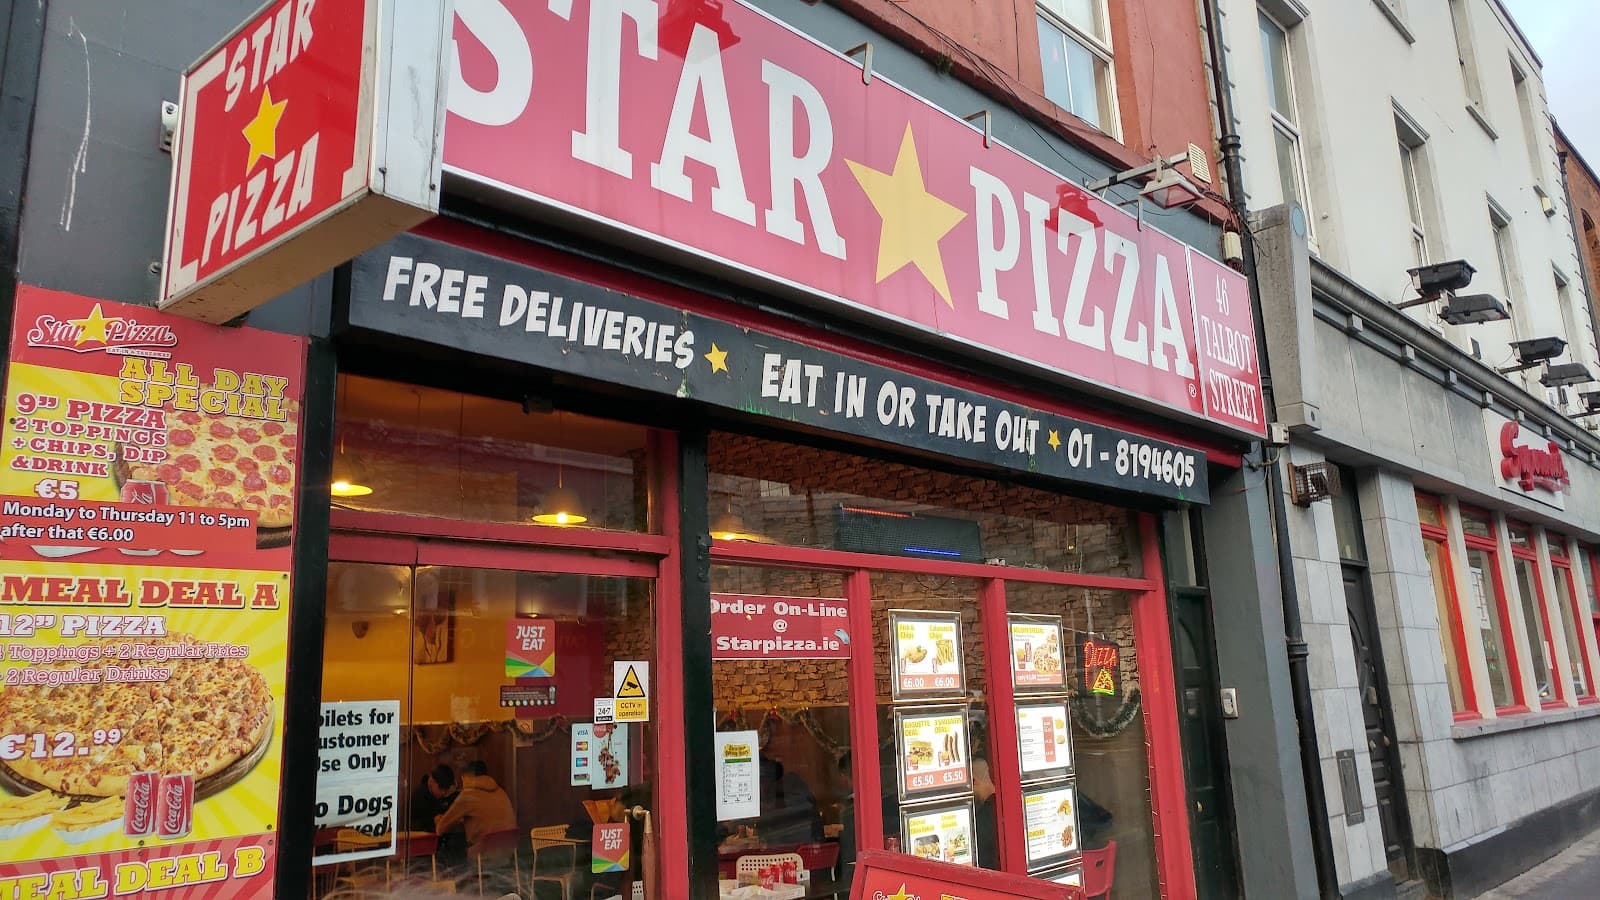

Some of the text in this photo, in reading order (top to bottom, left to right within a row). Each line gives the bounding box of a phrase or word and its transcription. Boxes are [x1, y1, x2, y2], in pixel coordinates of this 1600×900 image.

[224, 0, 317, 112] STAR
[201, 132, 319, 267] PIZZA
[445, 0, 847, 260] STAR
[969, 165, 1195, 380] PIZZA
[1215, 273, 1230, 316] 46
[27, 315, 175, 344] Star Pizza
[1201, 315, 1253, 374] TALBOT
[121, 357, 288, 399] ALL DAY
[382, 256, 488, 319] FREE
[499, 284, 695, 369] DELIVERIES
[760, 352, 823, 407] EAT
[834, 372, 867, 418] IN
[876, 381, 916, 429] OR
[926, 394, 987, 443] TAKE
[995, 410, 1040, 456] OUT
[1067, 428, 1094, 468] 01
[1115, 439, 1195, 488] 8194605
[120, 381, 287, 421] SPECIAL
[1209, 368, 1259, 425] STREET
[67, 399, 166, 429] PIZZA
[32, 418, 166, 446] TOPPINGS
[13, 437, 167, 463] + CHIPS, DIP
[35, 478, 79, 499] €5
[3, 501, 250, 528] Monday to Thursday 11 to 5pm
[0, 523, 134, 542] after that €6.00
[2, 575, 279, 608] MEAL DEAL A
[711, 600, 847, 618] Order On-Line
[61, 614, 167, 637] PIZZA
[516, 626, 545, 639] JUST
[773, 619, 788, 633] @
[10, 644, 99, 662] Toppings
[104, 646, 115, 657] +
[119, 644, 130, 658] 2
[134, 644, 204, 663] Regular
[207, 644, 248, 659] Fries
[522, 638, 545, 651] EAT
[716, 636, 839, 654] Starpizza.ie
[6, 666, 169, 687] 2 Regular Drinks
[369, 708, 394, 725] for
[318, 731, 390, 750] ustomer
[348, 751, 387, 773] Only
[912, 774, 934, 787] €5.50
[943, 770, 963, 783] €5.50
[338, 795, 393, 817] Dogs
[600, 829, 623, 841] JUST
[604, 840, 622, 850] EAT
[114, 851, 228, 896] DEAL
[233, 846, 265, 878] B
